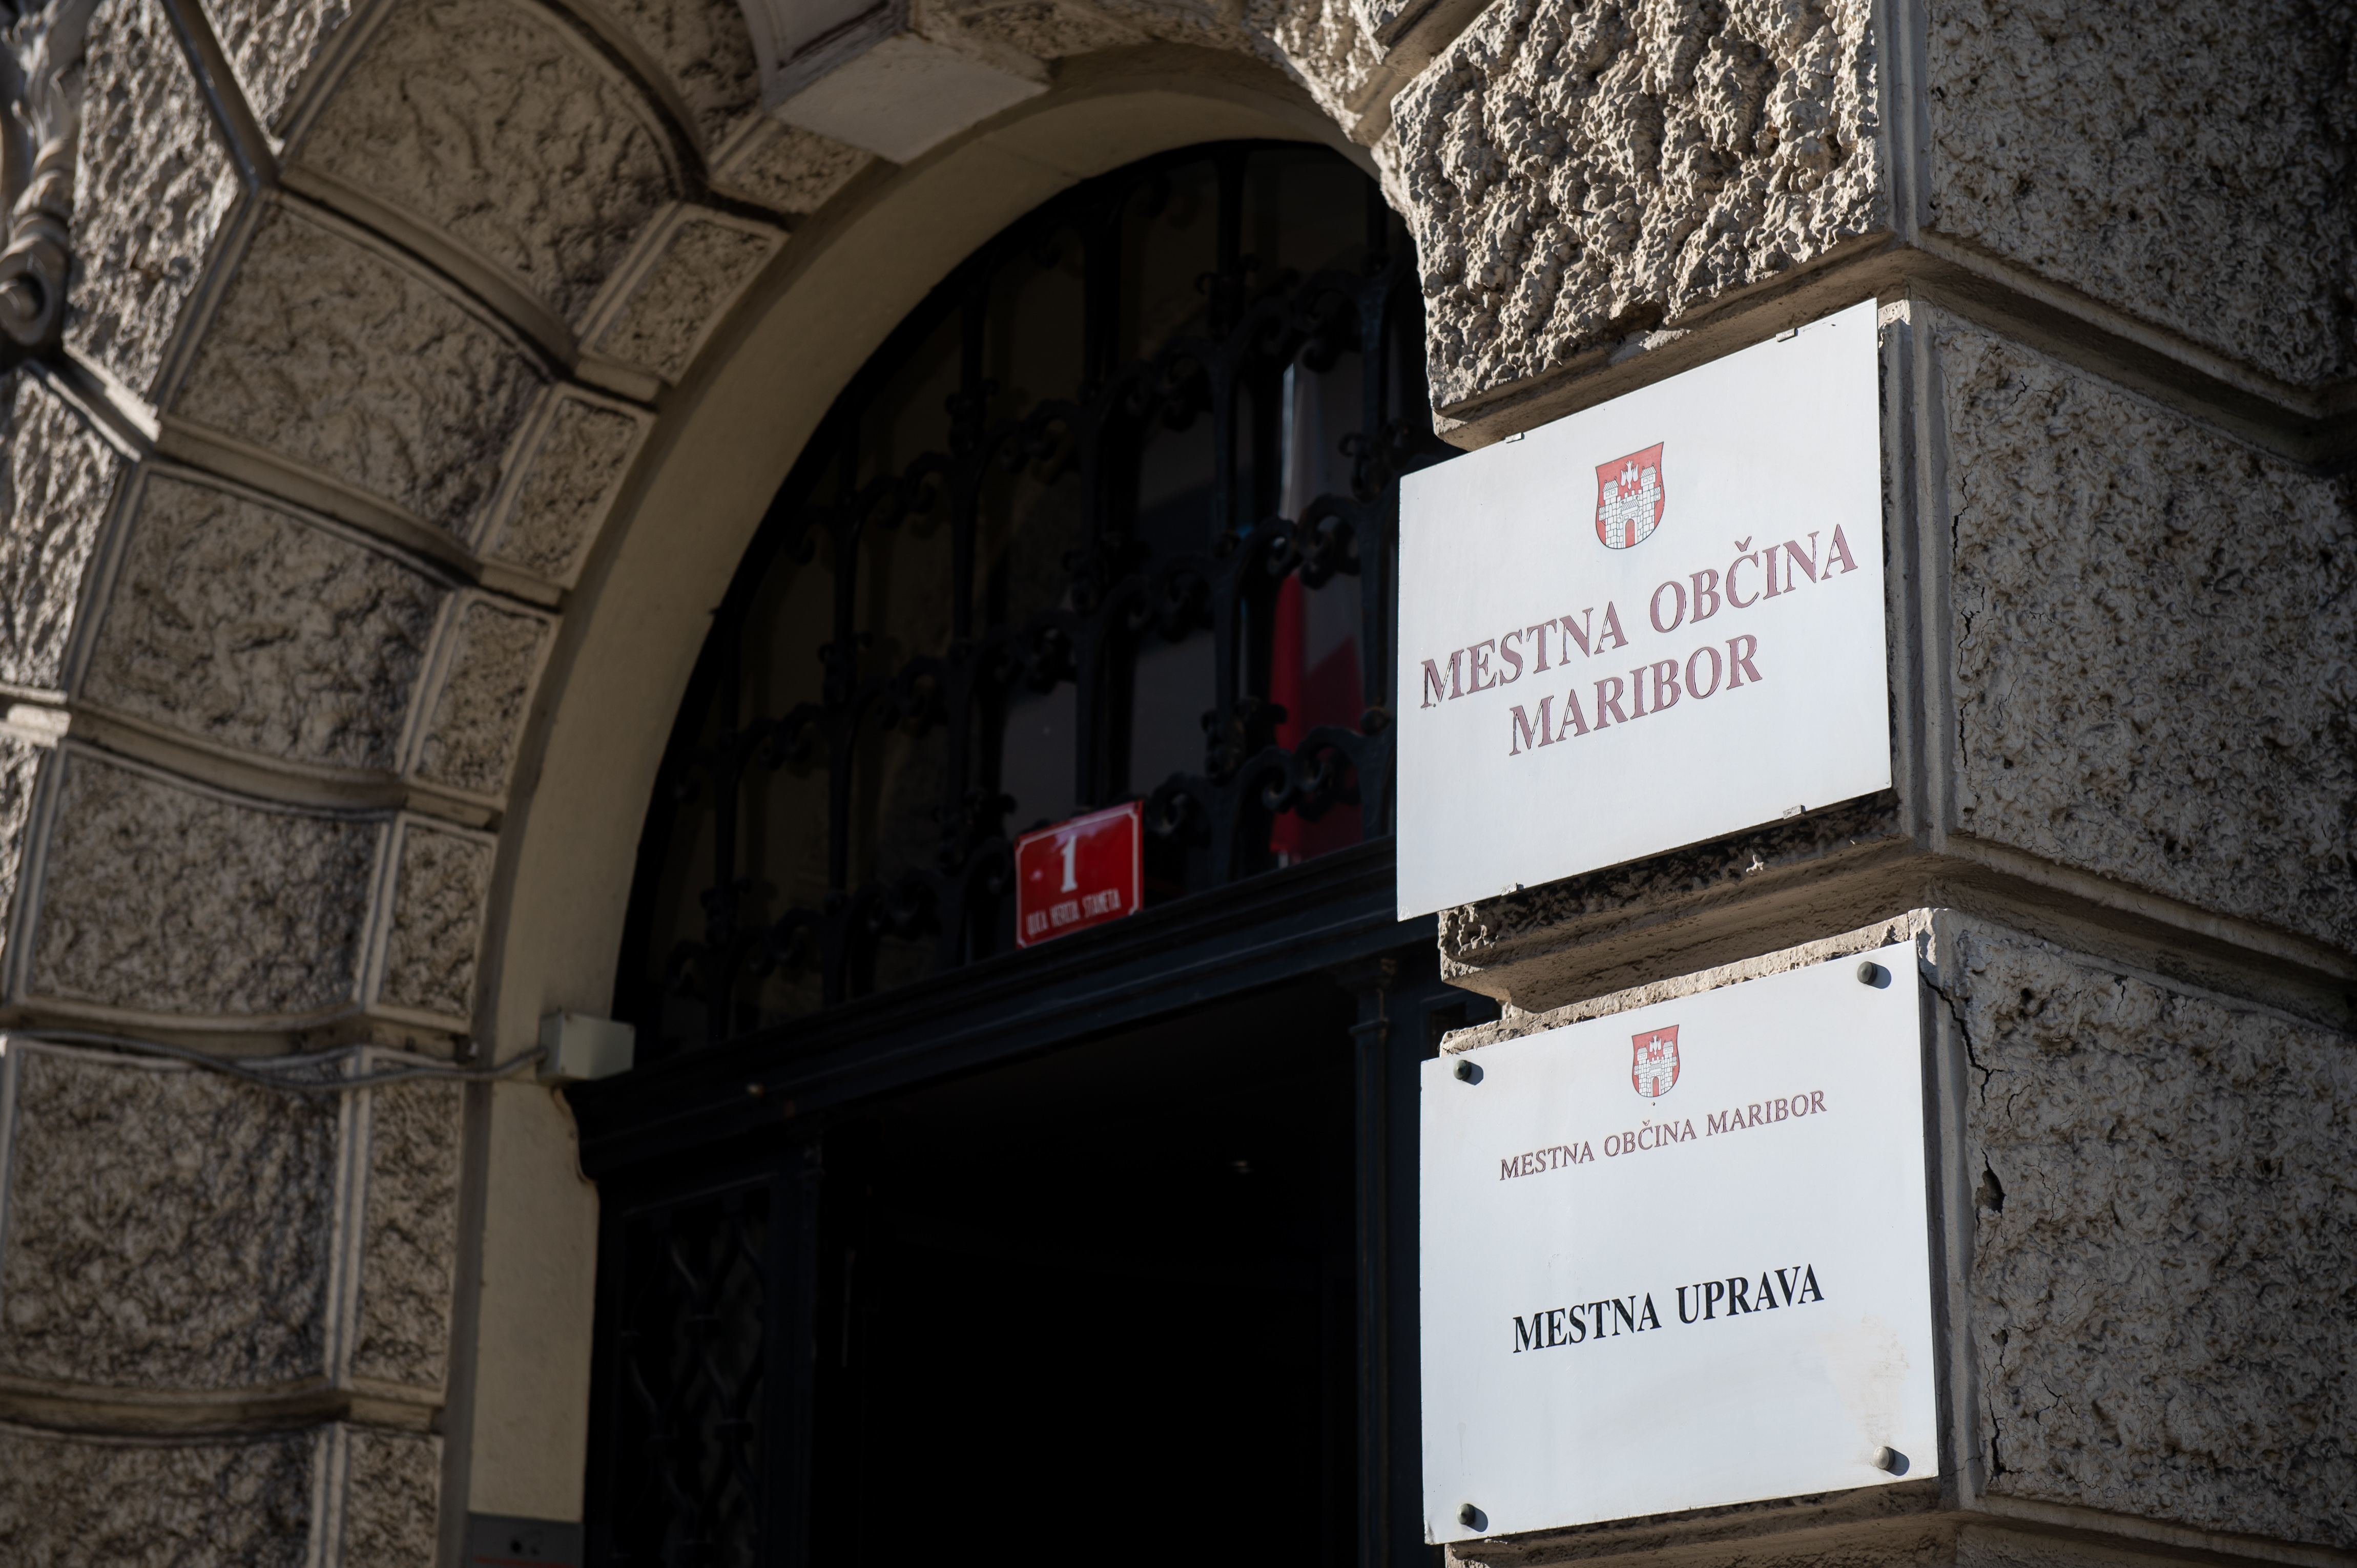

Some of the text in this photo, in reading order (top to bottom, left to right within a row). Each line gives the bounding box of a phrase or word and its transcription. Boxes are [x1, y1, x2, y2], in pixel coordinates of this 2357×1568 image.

[1420, 524, 1858, 710] MESTNA OBČINA
[1508, 634, 1763, 757] MARIBOR
[1060, 834, 1078, 893] 1
[1499, 1090, 1827, 1181] MESTNA OBČINA MARIBOR
[1513, 1263, 1825, 1353] MESTNA UPRAVA
